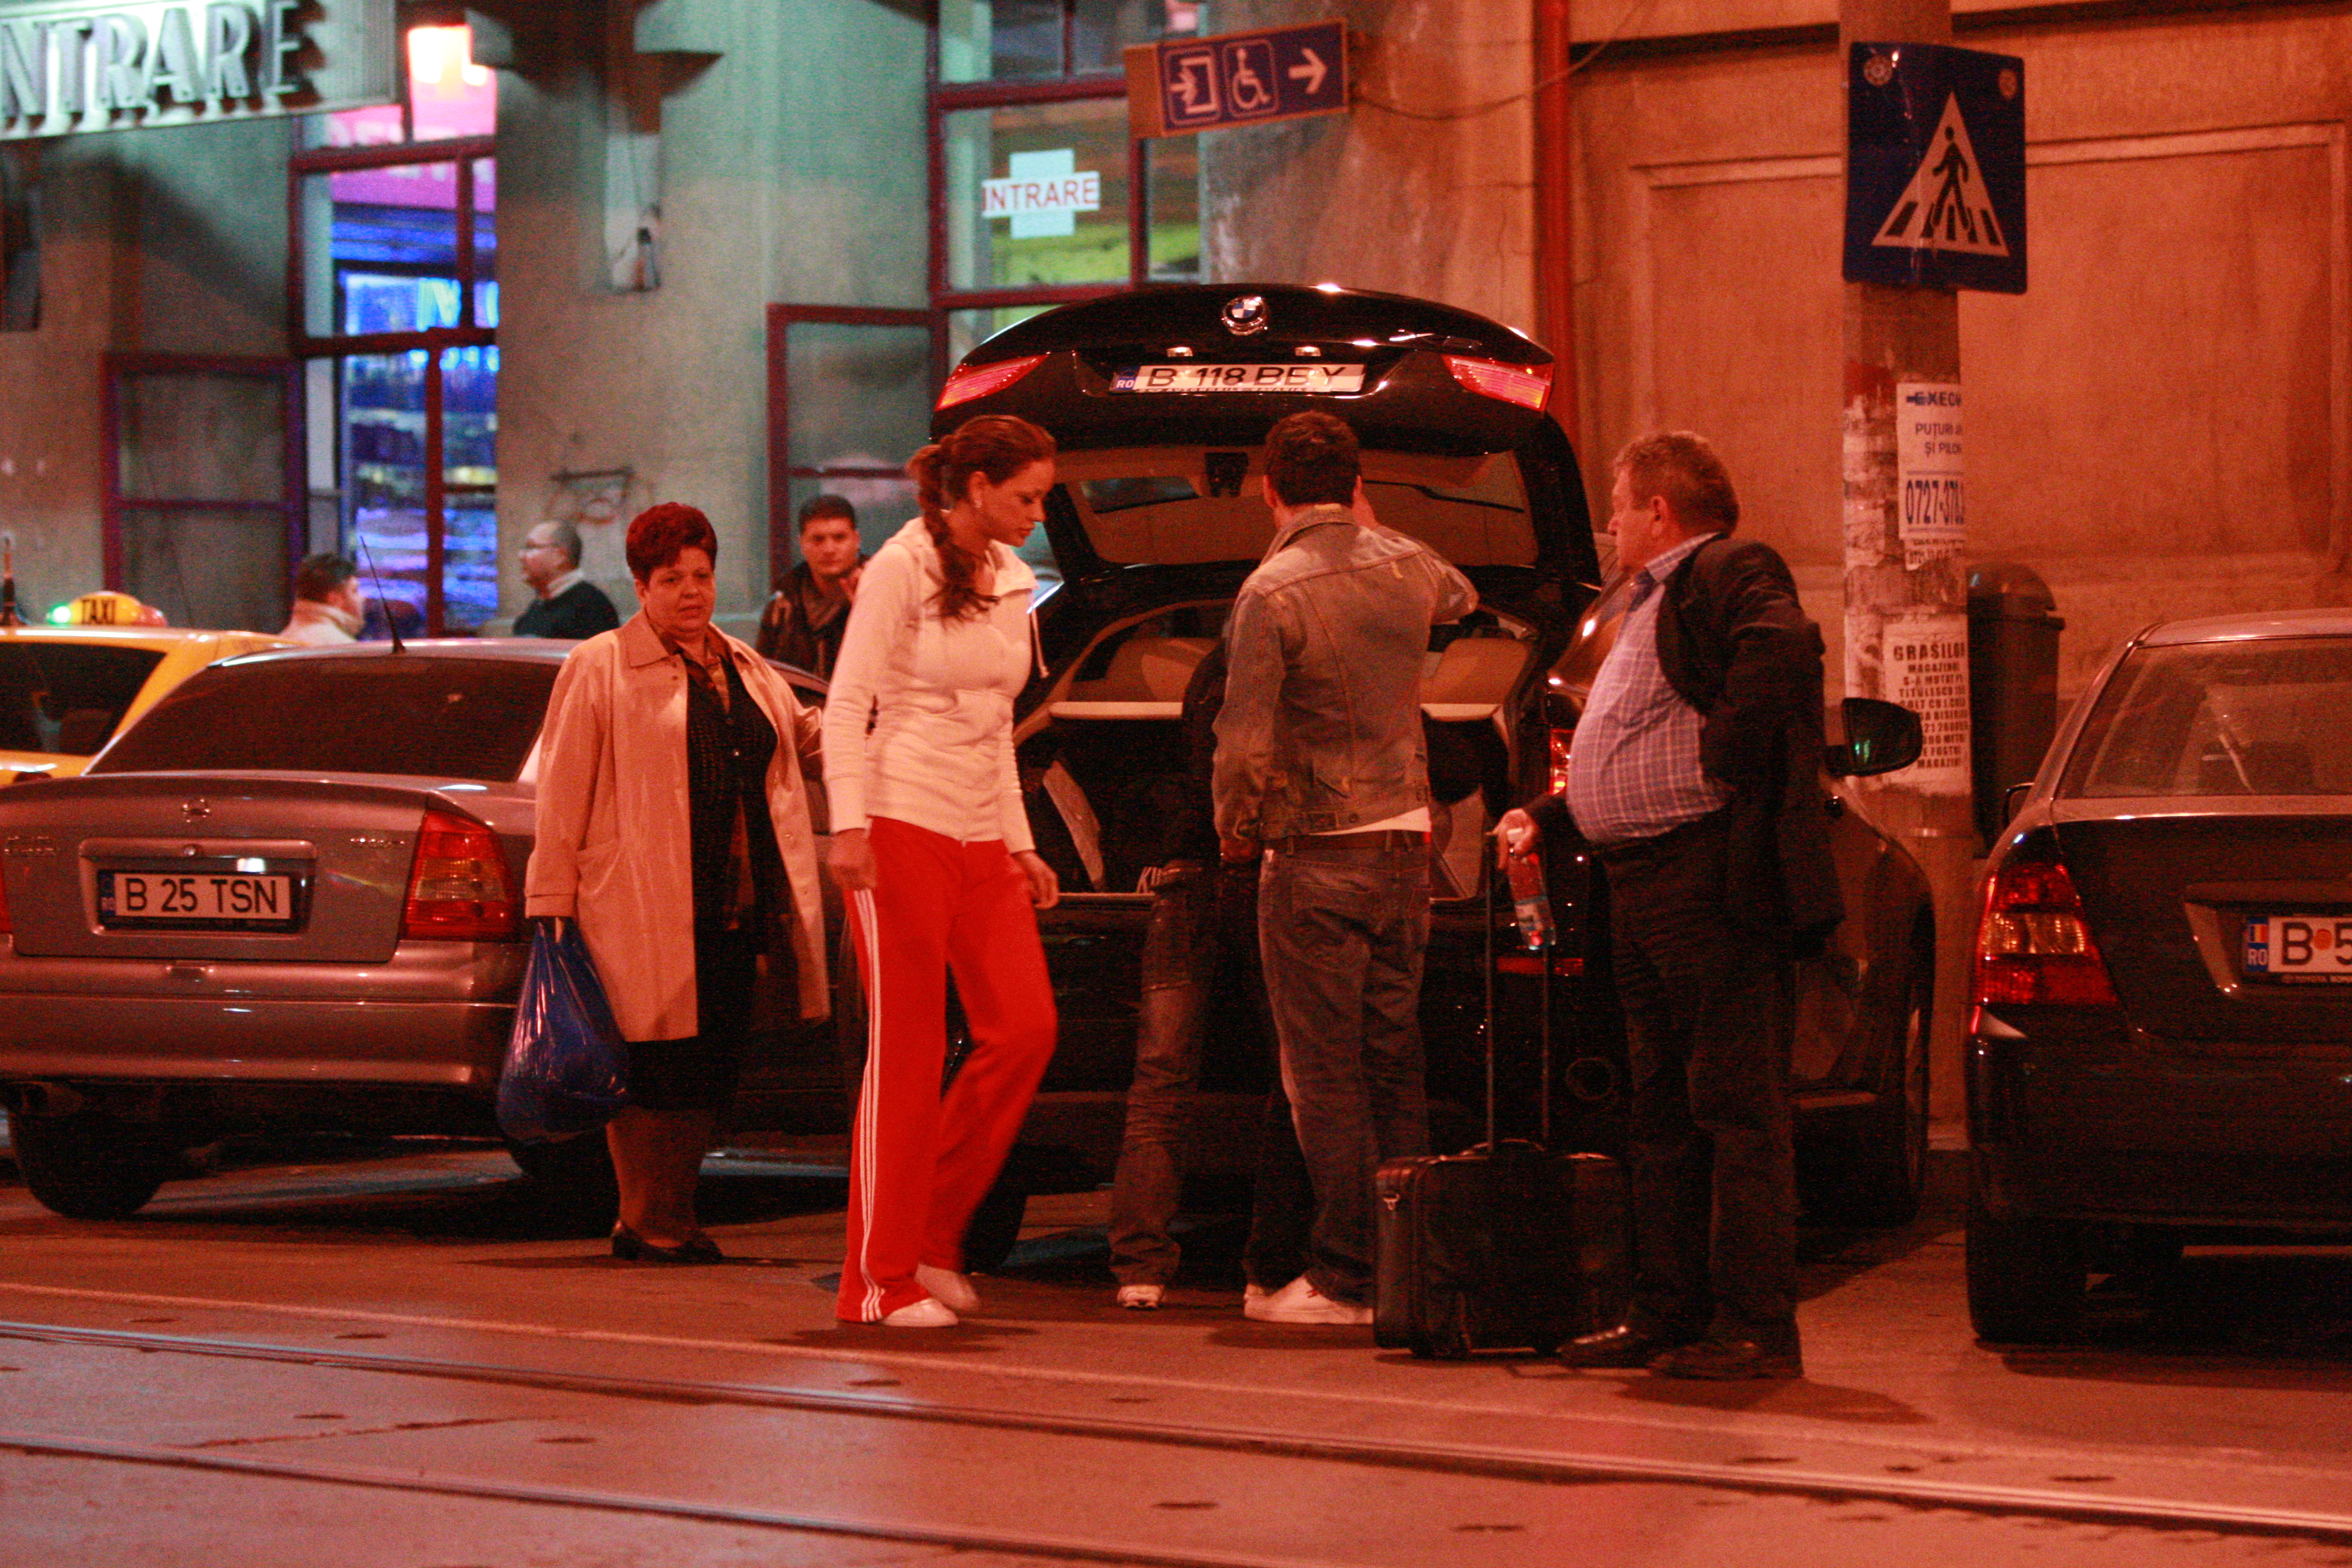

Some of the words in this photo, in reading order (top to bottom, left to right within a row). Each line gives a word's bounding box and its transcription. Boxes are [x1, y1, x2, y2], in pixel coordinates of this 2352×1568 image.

[982, 179, 1099, 210] INTRARE
[1116, 380, 1135, 388] RO
[1148, 368, 1177, 387] B
[1195, 367, 1246, 386] 118
[81, 598, 116, 625] TAXI
[125, 878, 147, 911] B
[161, 878, 198, 912] 25
[210, 879, 278, 914] TSN
[2247, 949, 2268, 965] RO
[2281, 921, 2313, 966] B
[2334, 922, 2352, 966] 5
